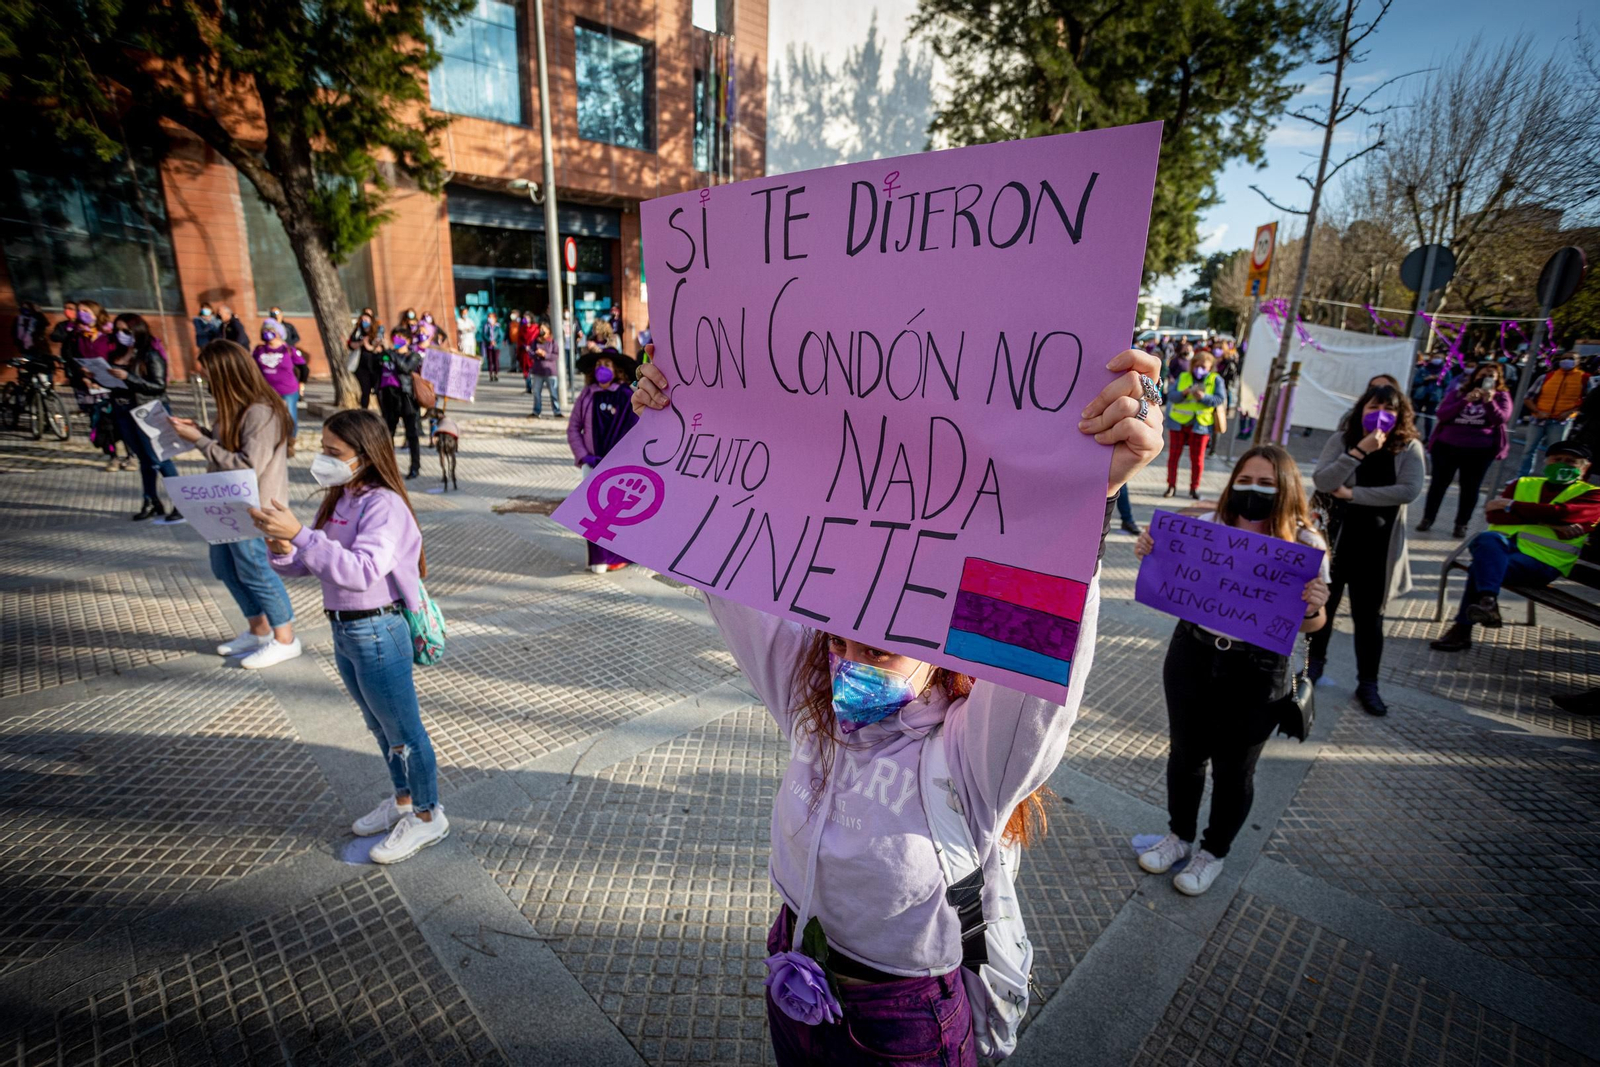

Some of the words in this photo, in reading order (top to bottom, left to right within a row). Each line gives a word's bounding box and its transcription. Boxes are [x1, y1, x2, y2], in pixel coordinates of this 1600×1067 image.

[750, 185, 810, 264] TE
[845, 172, 1100, 257] DIJERON
[669, 277, 746, 389] CON
[767, 277, 966, 401] CONDÓN
[985, 330, 1083, 412] NO
[642, 383, 771, 491] SIENTO
[825, 409, 1006, 535] NADA
[180, 481, 252, 500] SEGUIMOS
[1157, 515, 1214, 542] FELIZ
[1227, 535, 1250, 550] VA
[1256, 543, 1268, 556] A
[1274, 549, 1306, 568] SER
[1169, 540, 1187, 555] EL
[1201, 547, 1235, 570] DIA
[1252, 563, 1298, 586] QUE
[667, 494, 959, 650] ÚNETE
[1174, 563, 1202, 582] NO
[1219, 577, 1278, 604] FALTE
[1158, 581, 1258, 626] NINGUNA
